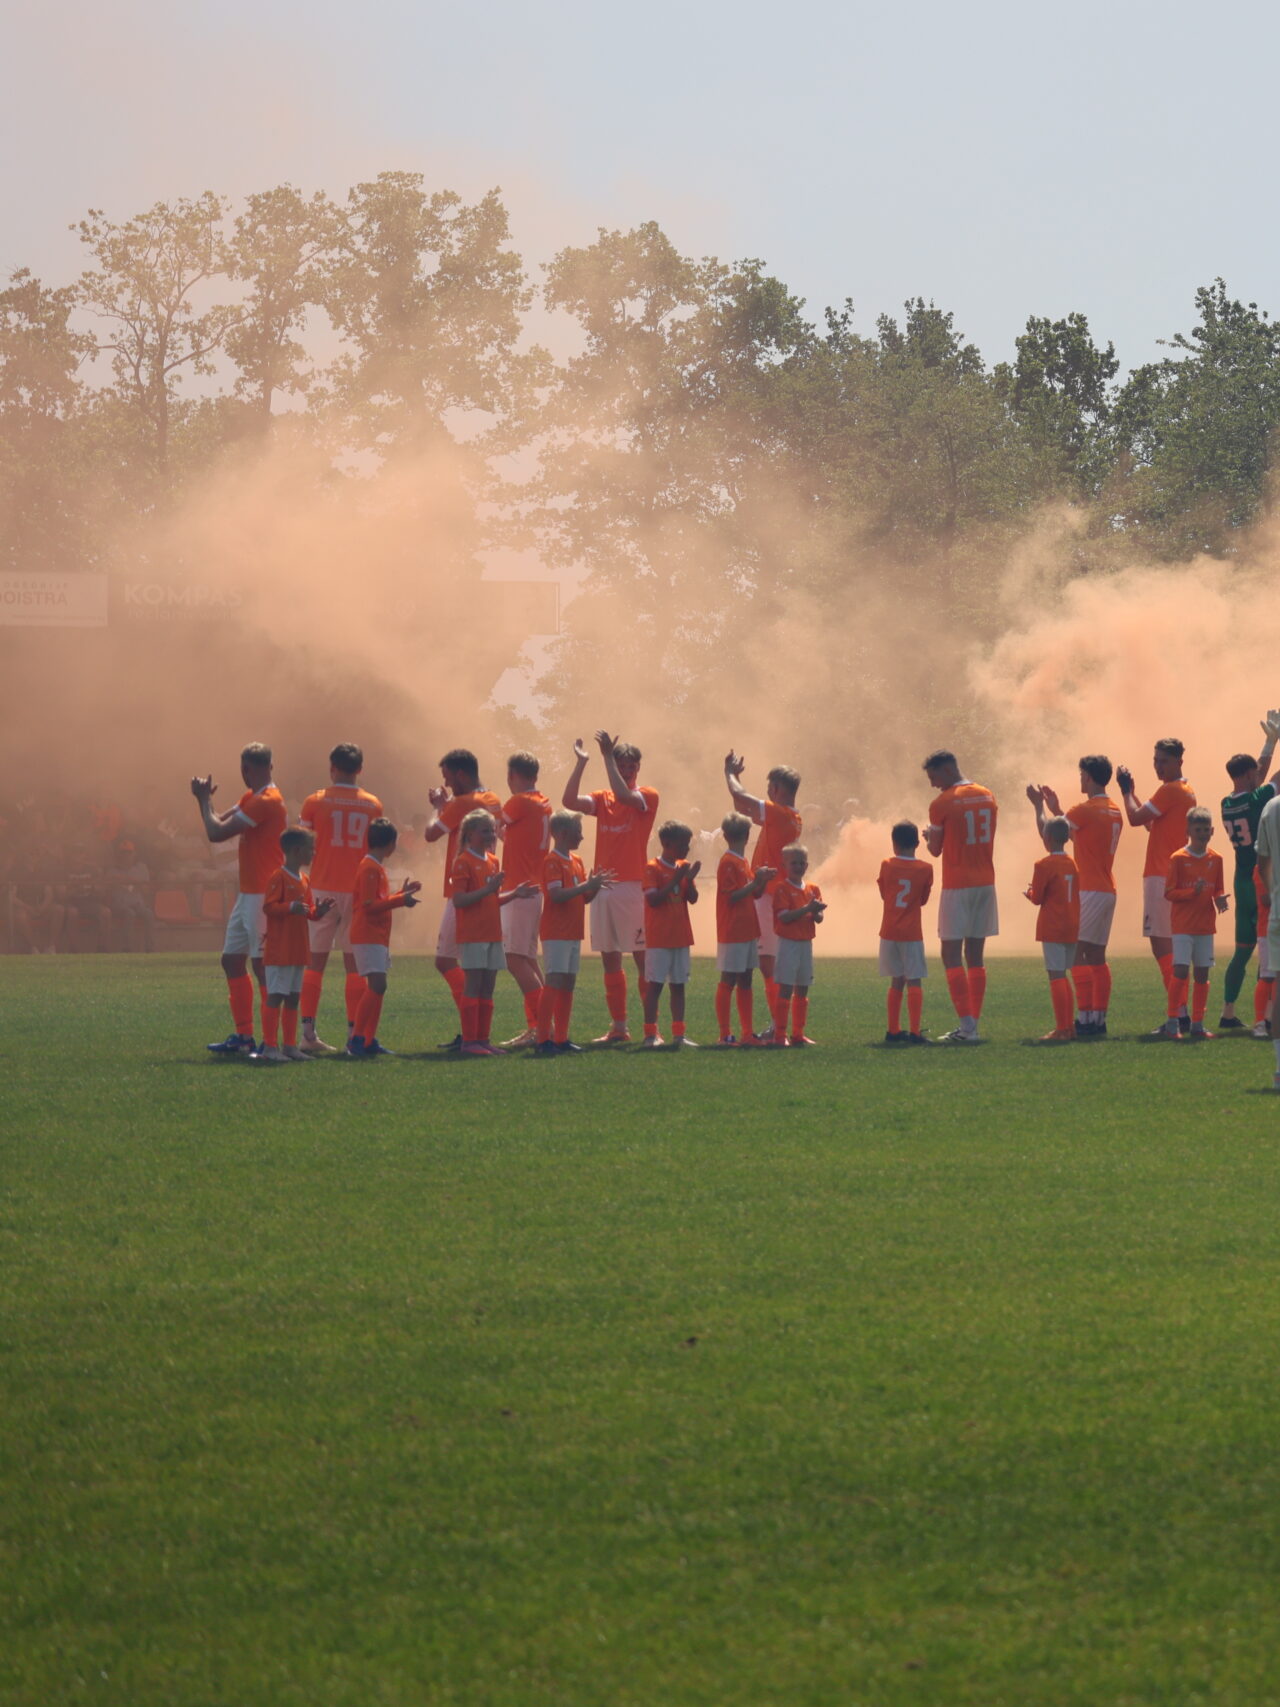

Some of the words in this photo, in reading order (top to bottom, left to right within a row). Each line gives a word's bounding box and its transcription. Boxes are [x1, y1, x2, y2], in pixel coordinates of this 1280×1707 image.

[0, 591, 68, 606] OISTRA
[123, 583, 242, 608] KOMPAS
[330, 810, 368, 849] 19
[964, 808, 991, 845] 13
[895, 879, 912, 908] 2
